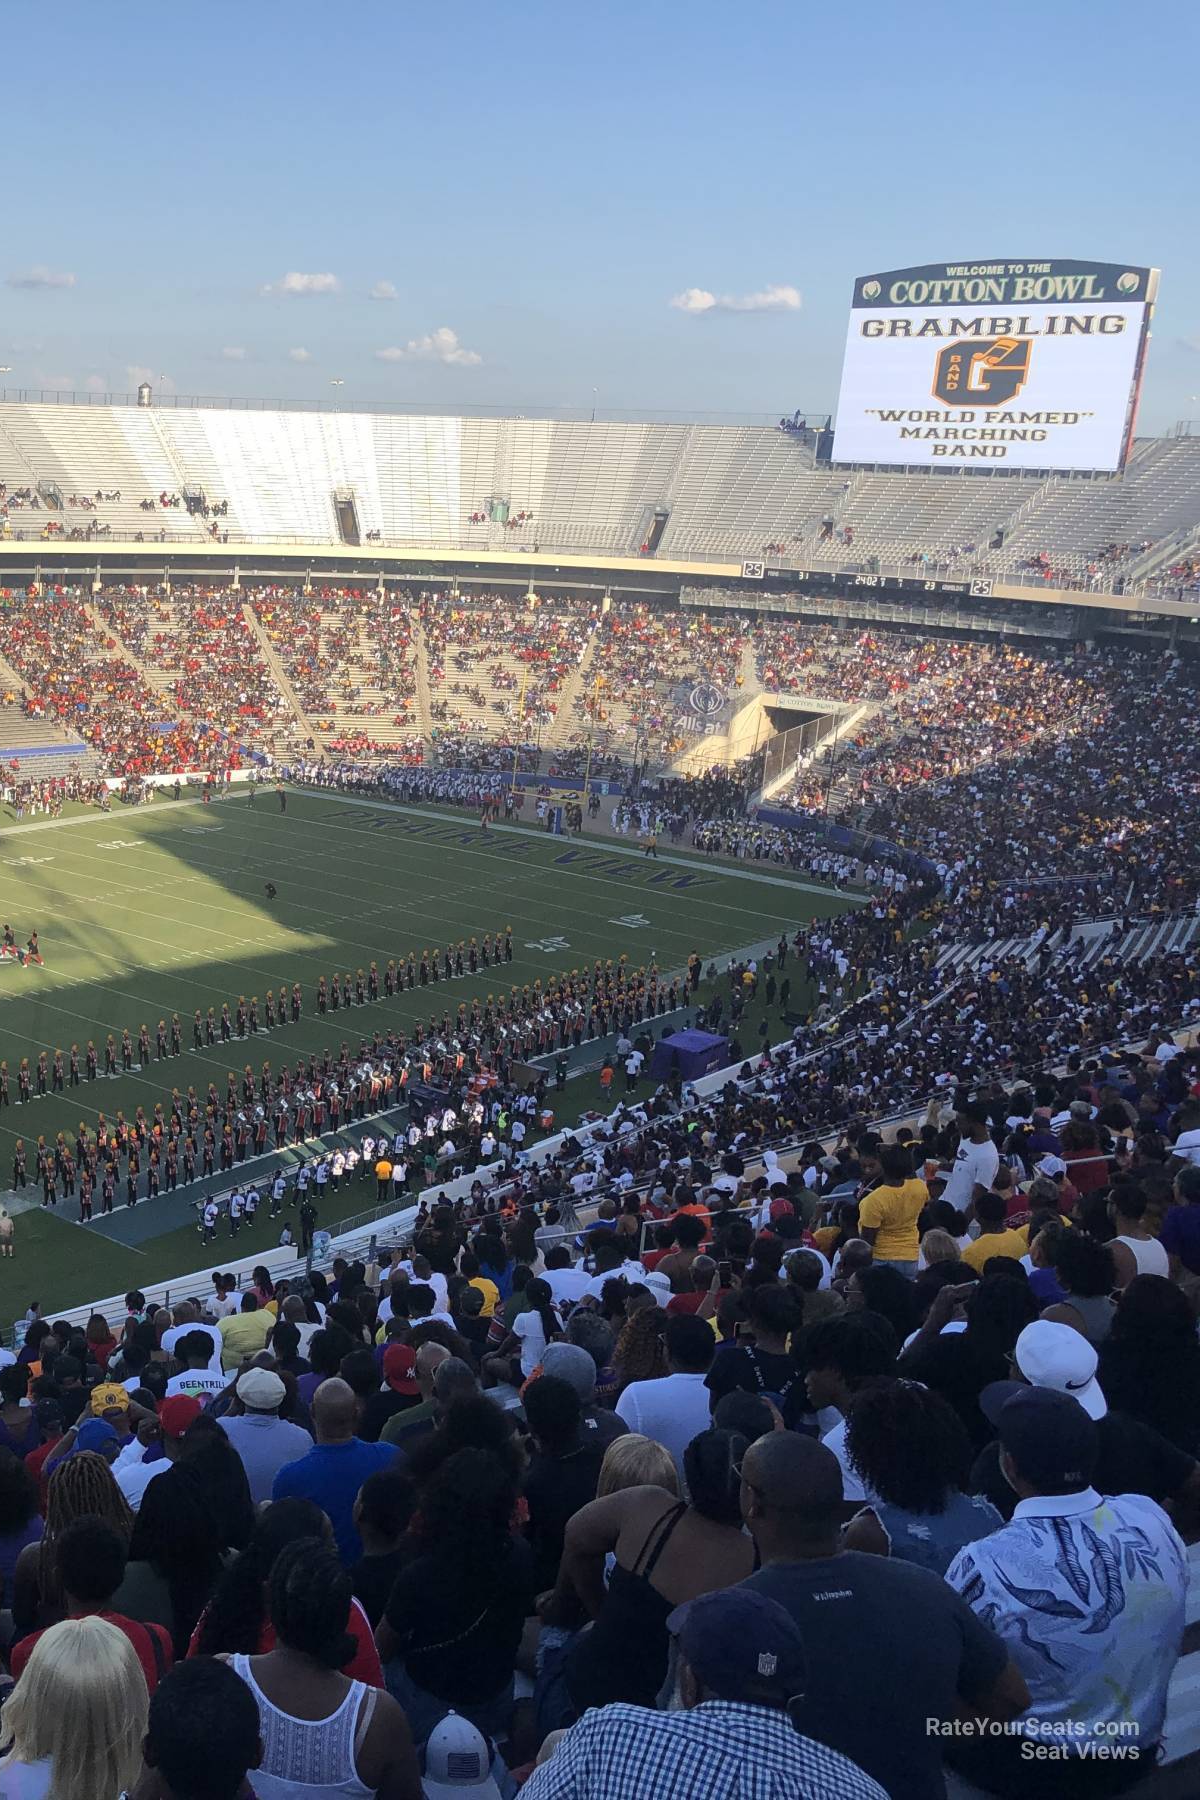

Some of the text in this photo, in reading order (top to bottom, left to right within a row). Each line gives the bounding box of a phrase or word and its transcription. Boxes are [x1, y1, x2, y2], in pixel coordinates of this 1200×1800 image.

[946, 263, 1051, 276] WELCOME TO THE
[889, 274, 1104, 304] COTTON BOWL
[861, 314, 1125, 337] GRAMBLING
[946, 355, 961, 390] BAND
[899, 427, 1048, 442] MARCHING
[931, 444, 1008, 458] BAND
[746, 563, 761, 576] 25
[799, 571, 809, 580] 31
[924, 581, 936, 590] 23
[973, 580, 989, 594] 25
[321, 809, 722, 890] PRAIRIE VIEW
[523, 938, 571, 953] 20
